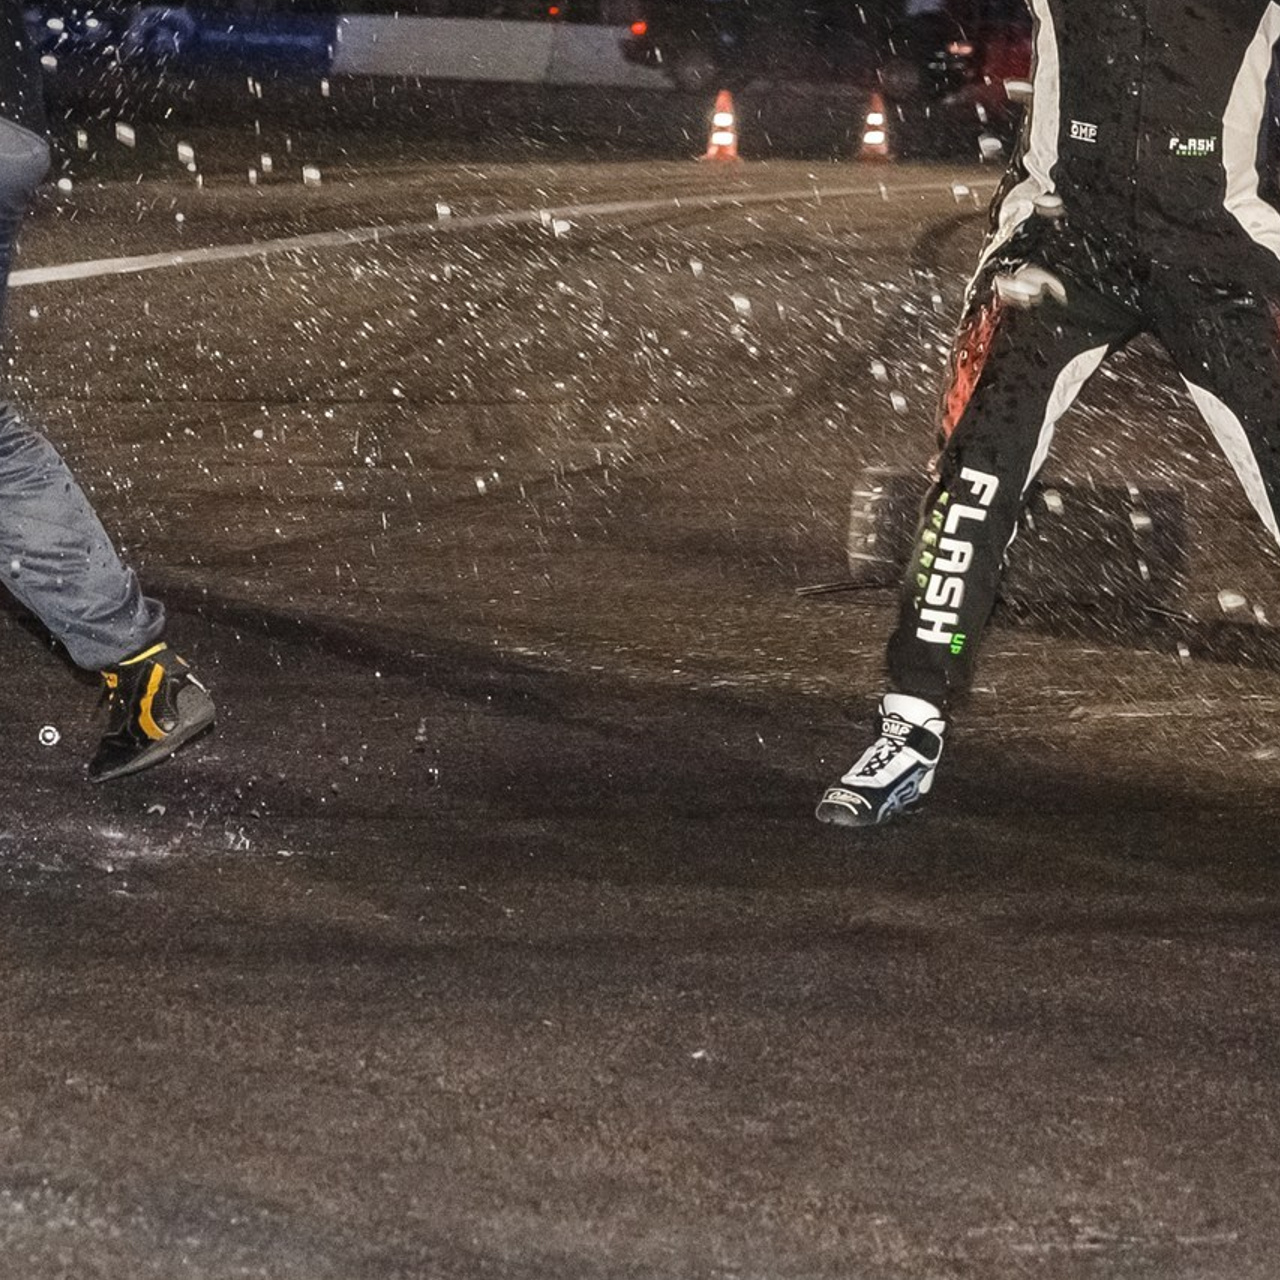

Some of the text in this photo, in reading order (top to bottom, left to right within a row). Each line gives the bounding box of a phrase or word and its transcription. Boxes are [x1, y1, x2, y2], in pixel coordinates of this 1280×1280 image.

[1070, 123, 1098, 139] OMP
[916, 467, 1000, 644] FLASH
[882, 721, 911, 736] OMP
